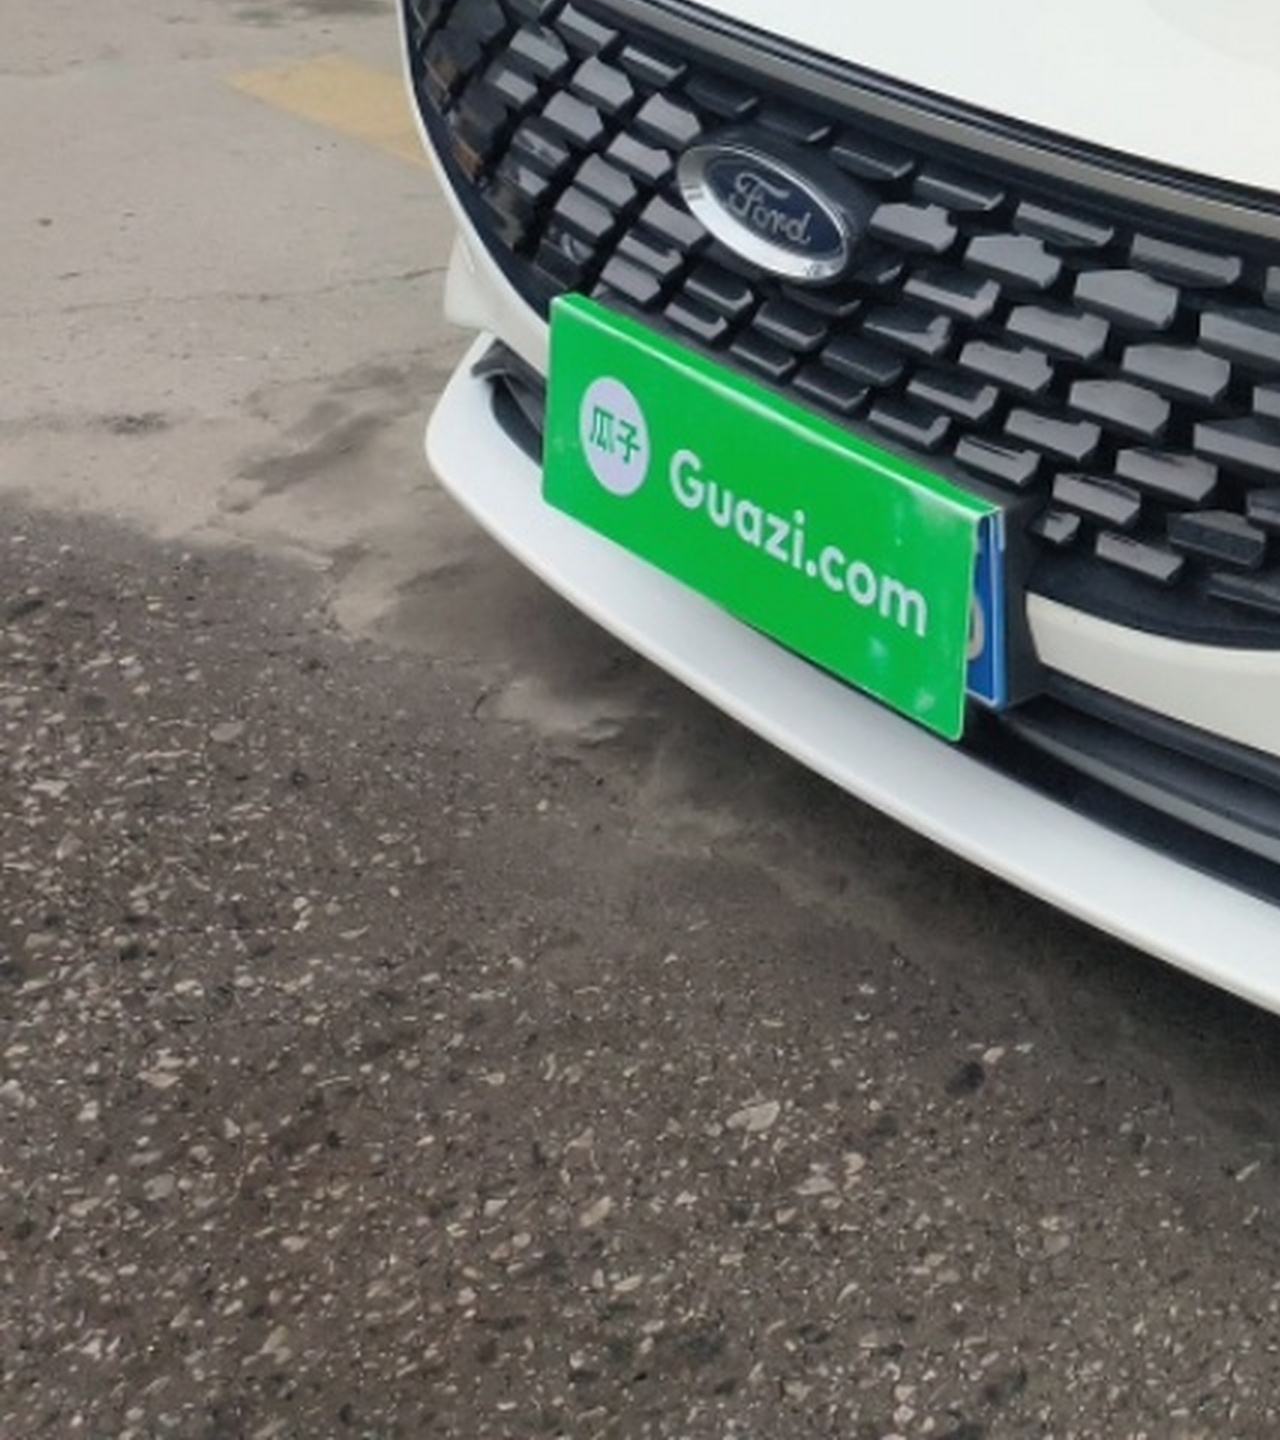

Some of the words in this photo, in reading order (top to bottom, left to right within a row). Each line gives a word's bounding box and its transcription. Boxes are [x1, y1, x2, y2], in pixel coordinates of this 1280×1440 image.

[726, 171, 812, 245] Ford
[588, 404, 641, 466] 瓜子
[668, 448, 927, 638] Guazi.com
